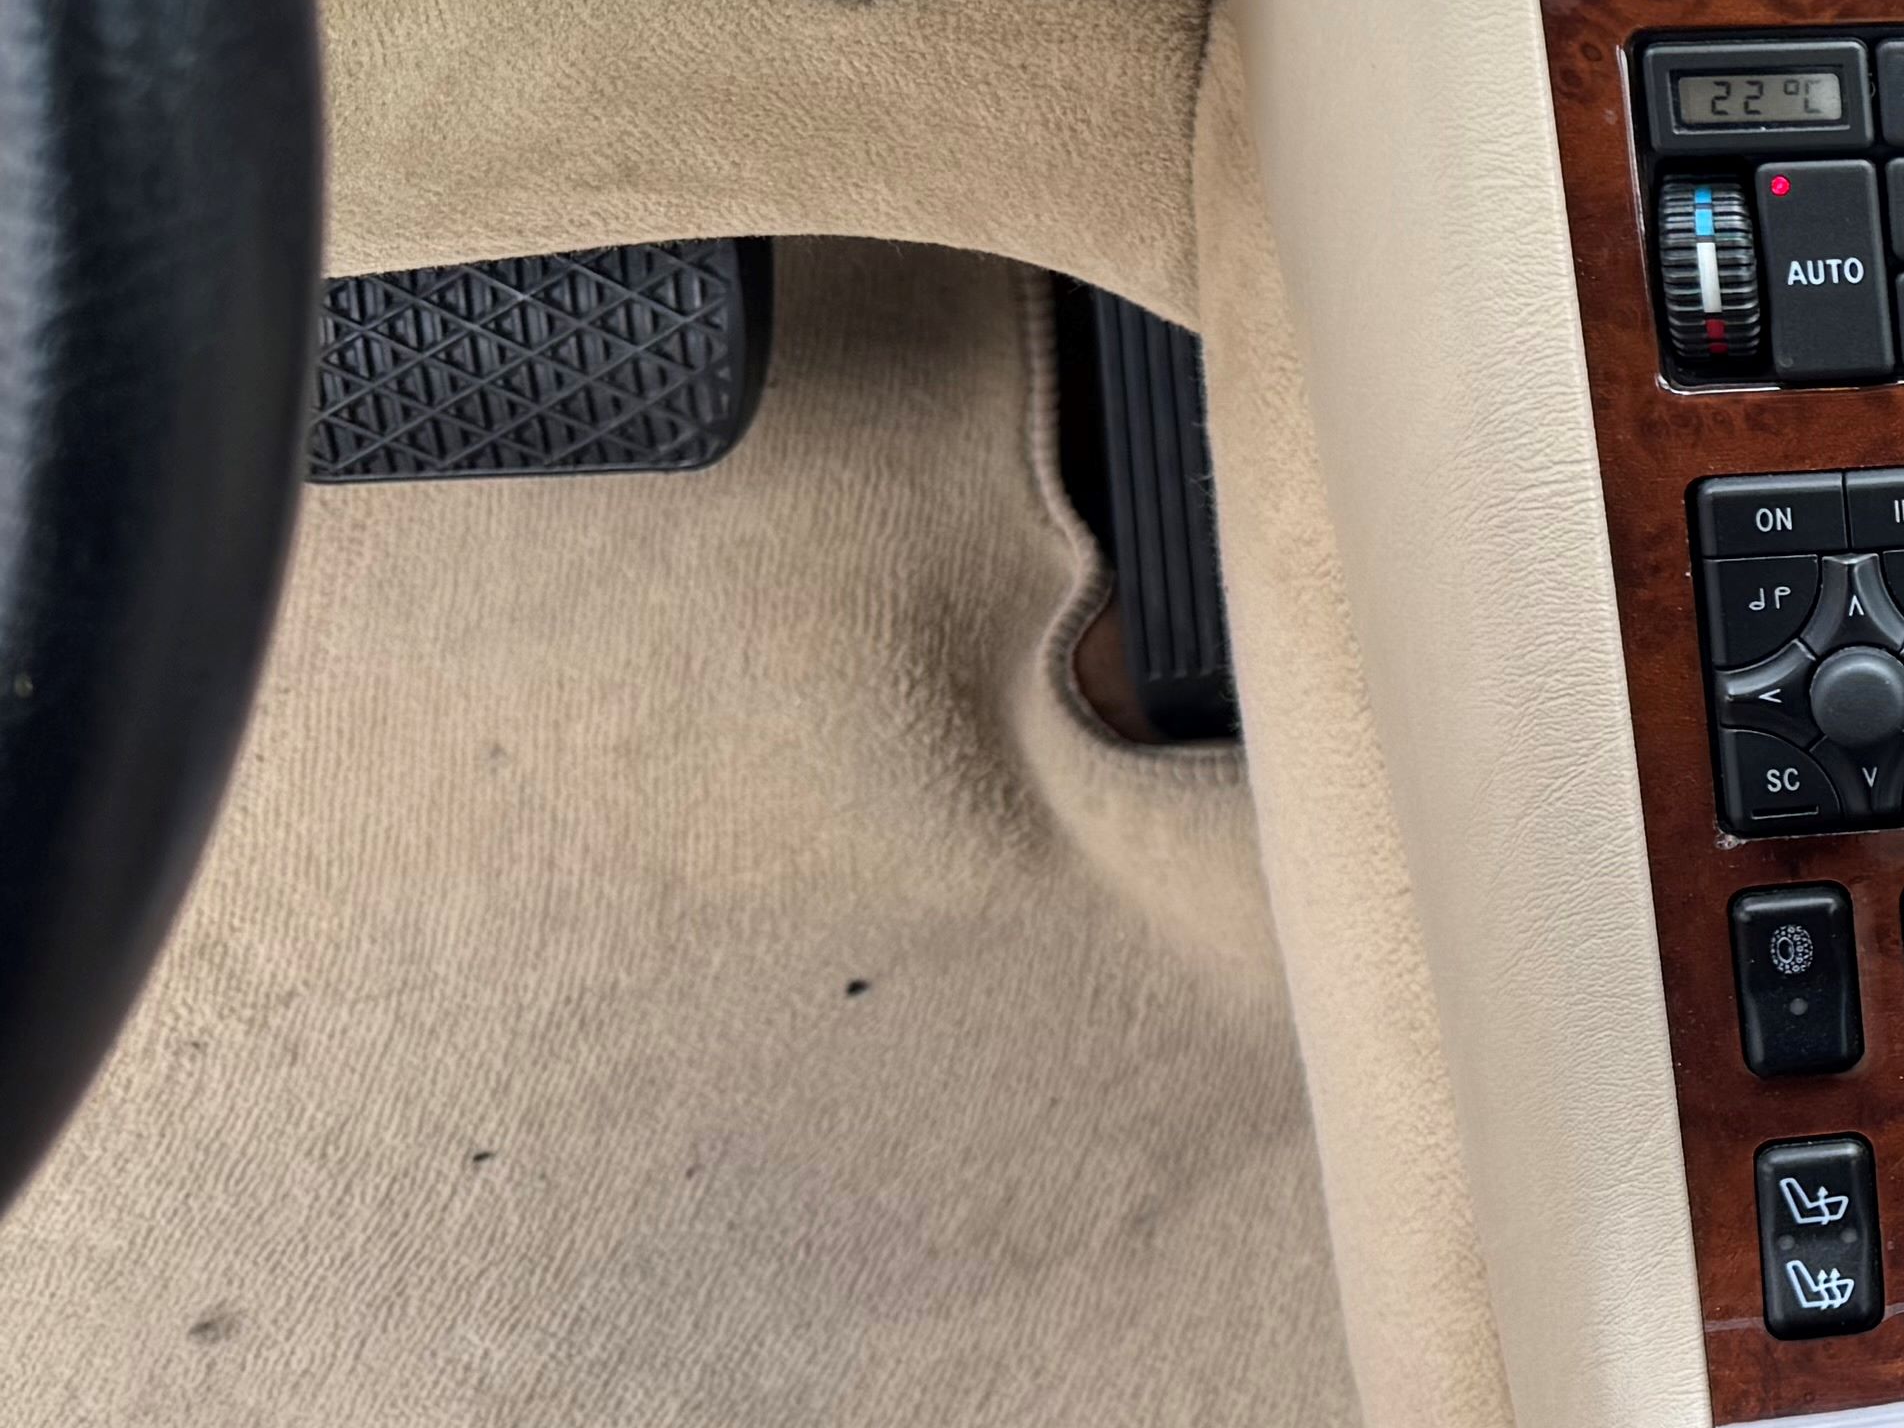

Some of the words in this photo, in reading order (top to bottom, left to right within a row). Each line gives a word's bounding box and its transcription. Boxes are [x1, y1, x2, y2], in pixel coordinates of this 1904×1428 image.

[1710, 80, 1764, 117] 22
[1787, 257, 1864, 285] AUTO
[1756, 508, 1792, 532] ON
[1766, 768, 1800, 793] SC
